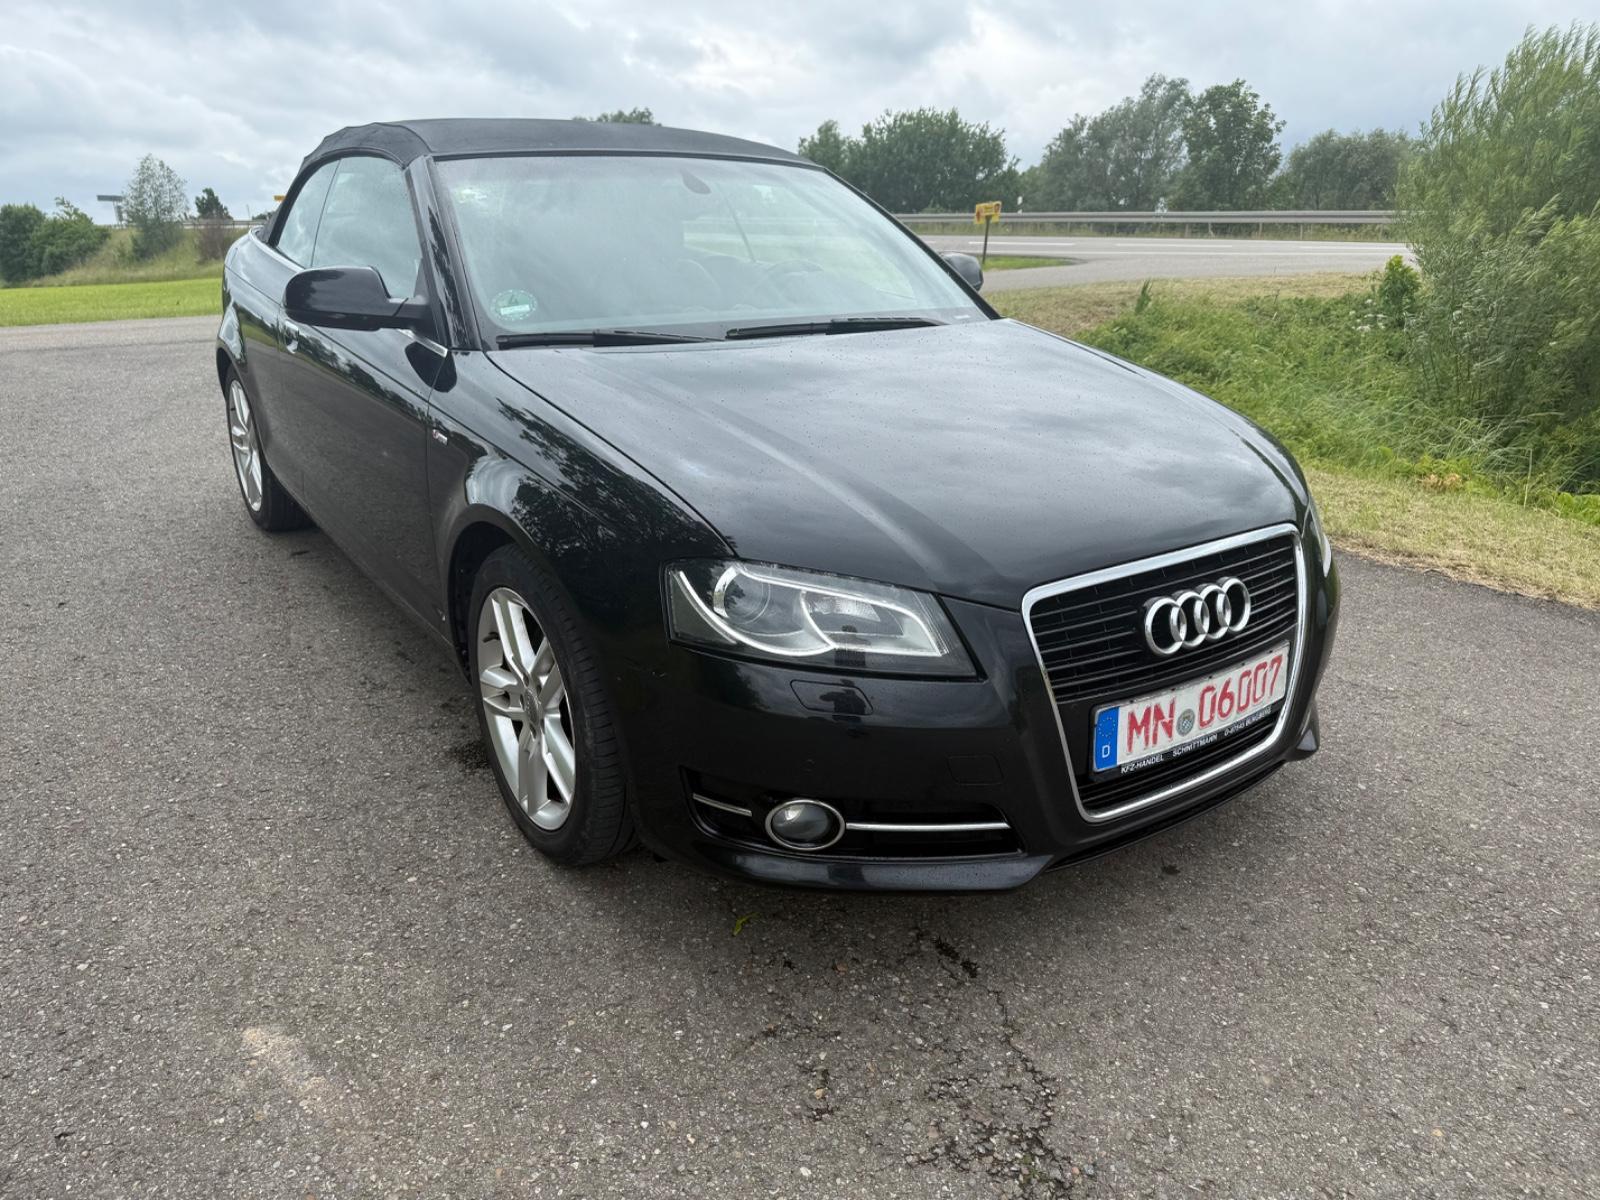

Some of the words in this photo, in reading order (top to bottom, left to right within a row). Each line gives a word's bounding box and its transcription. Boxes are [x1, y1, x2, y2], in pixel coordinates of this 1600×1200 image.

[1126, 697, 1176, 753] MN
[1199, 654, 1283, 729] 06007
[1102, 745, 1110, 758] D
[1121, 754, 1164, 774] KFZ-HANDEL
